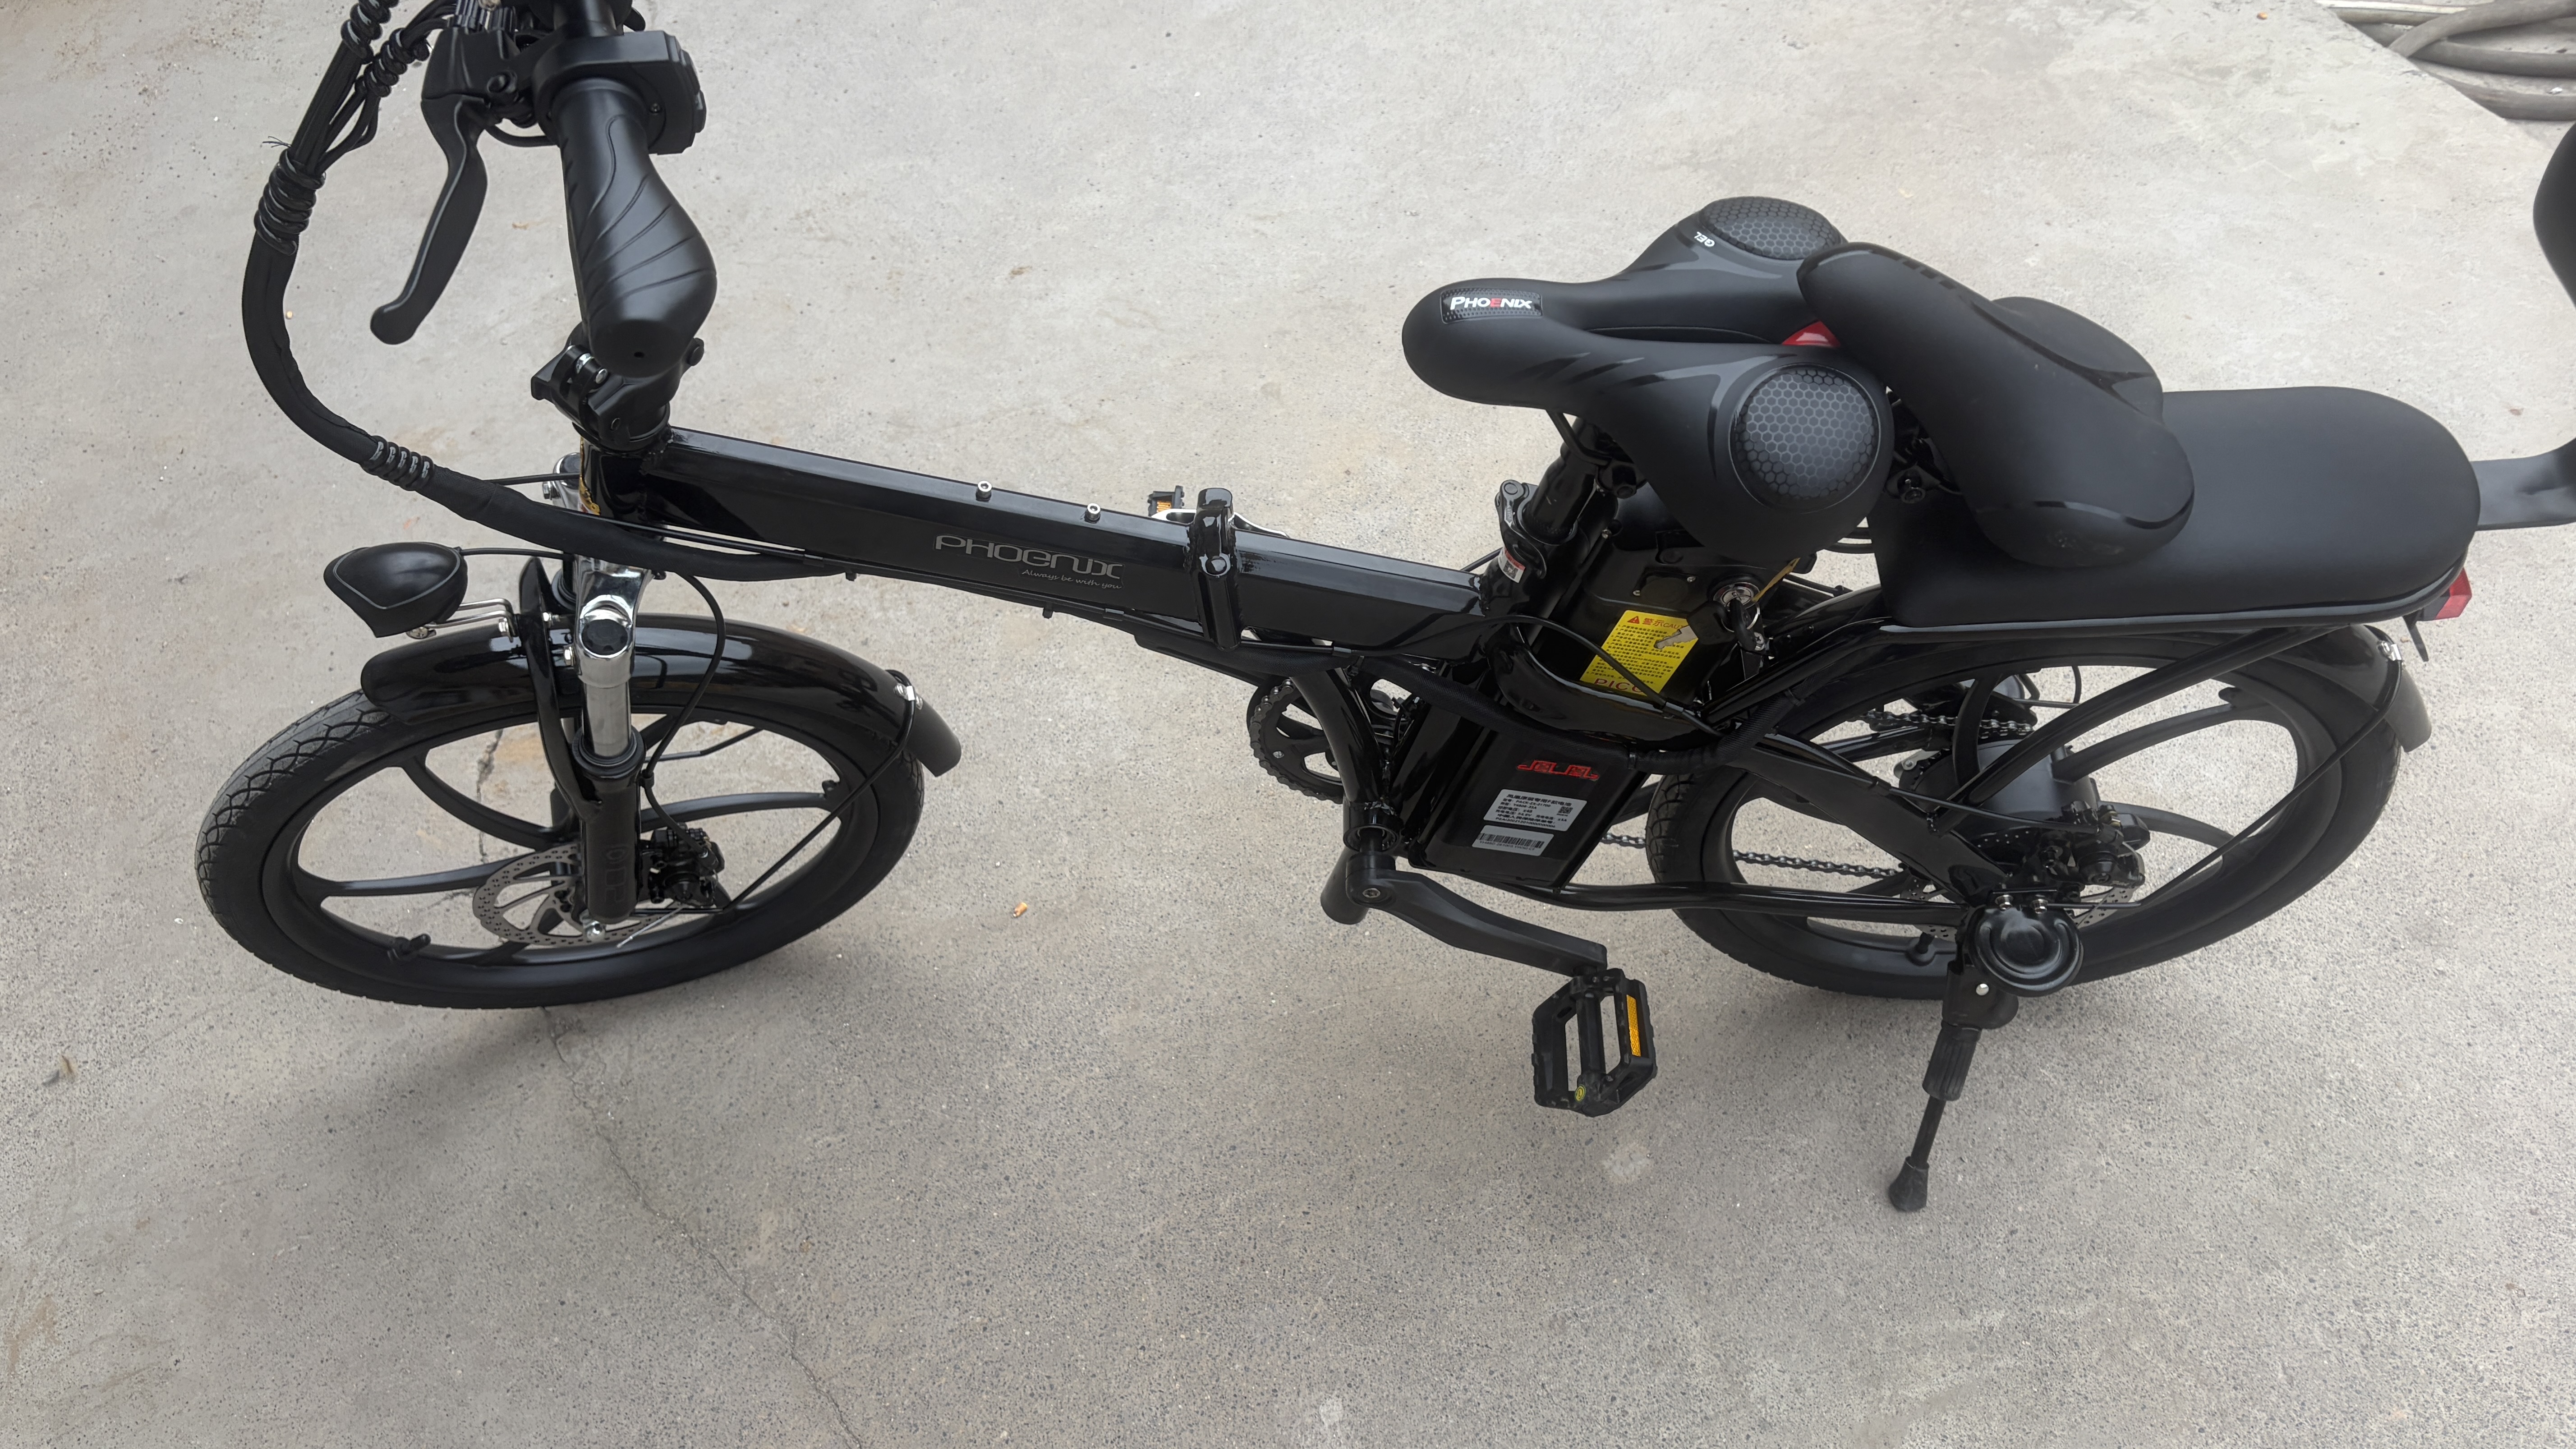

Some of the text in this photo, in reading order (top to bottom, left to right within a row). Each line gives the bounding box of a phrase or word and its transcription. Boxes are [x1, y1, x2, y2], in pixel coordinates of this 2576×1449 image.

[1693, 231, 1716, 248] GEL
[1449, 296, 1533, 310] PHOENIX
[1021, 569, 1060, 580] Always
[1075, 577, 1099, 586] with
